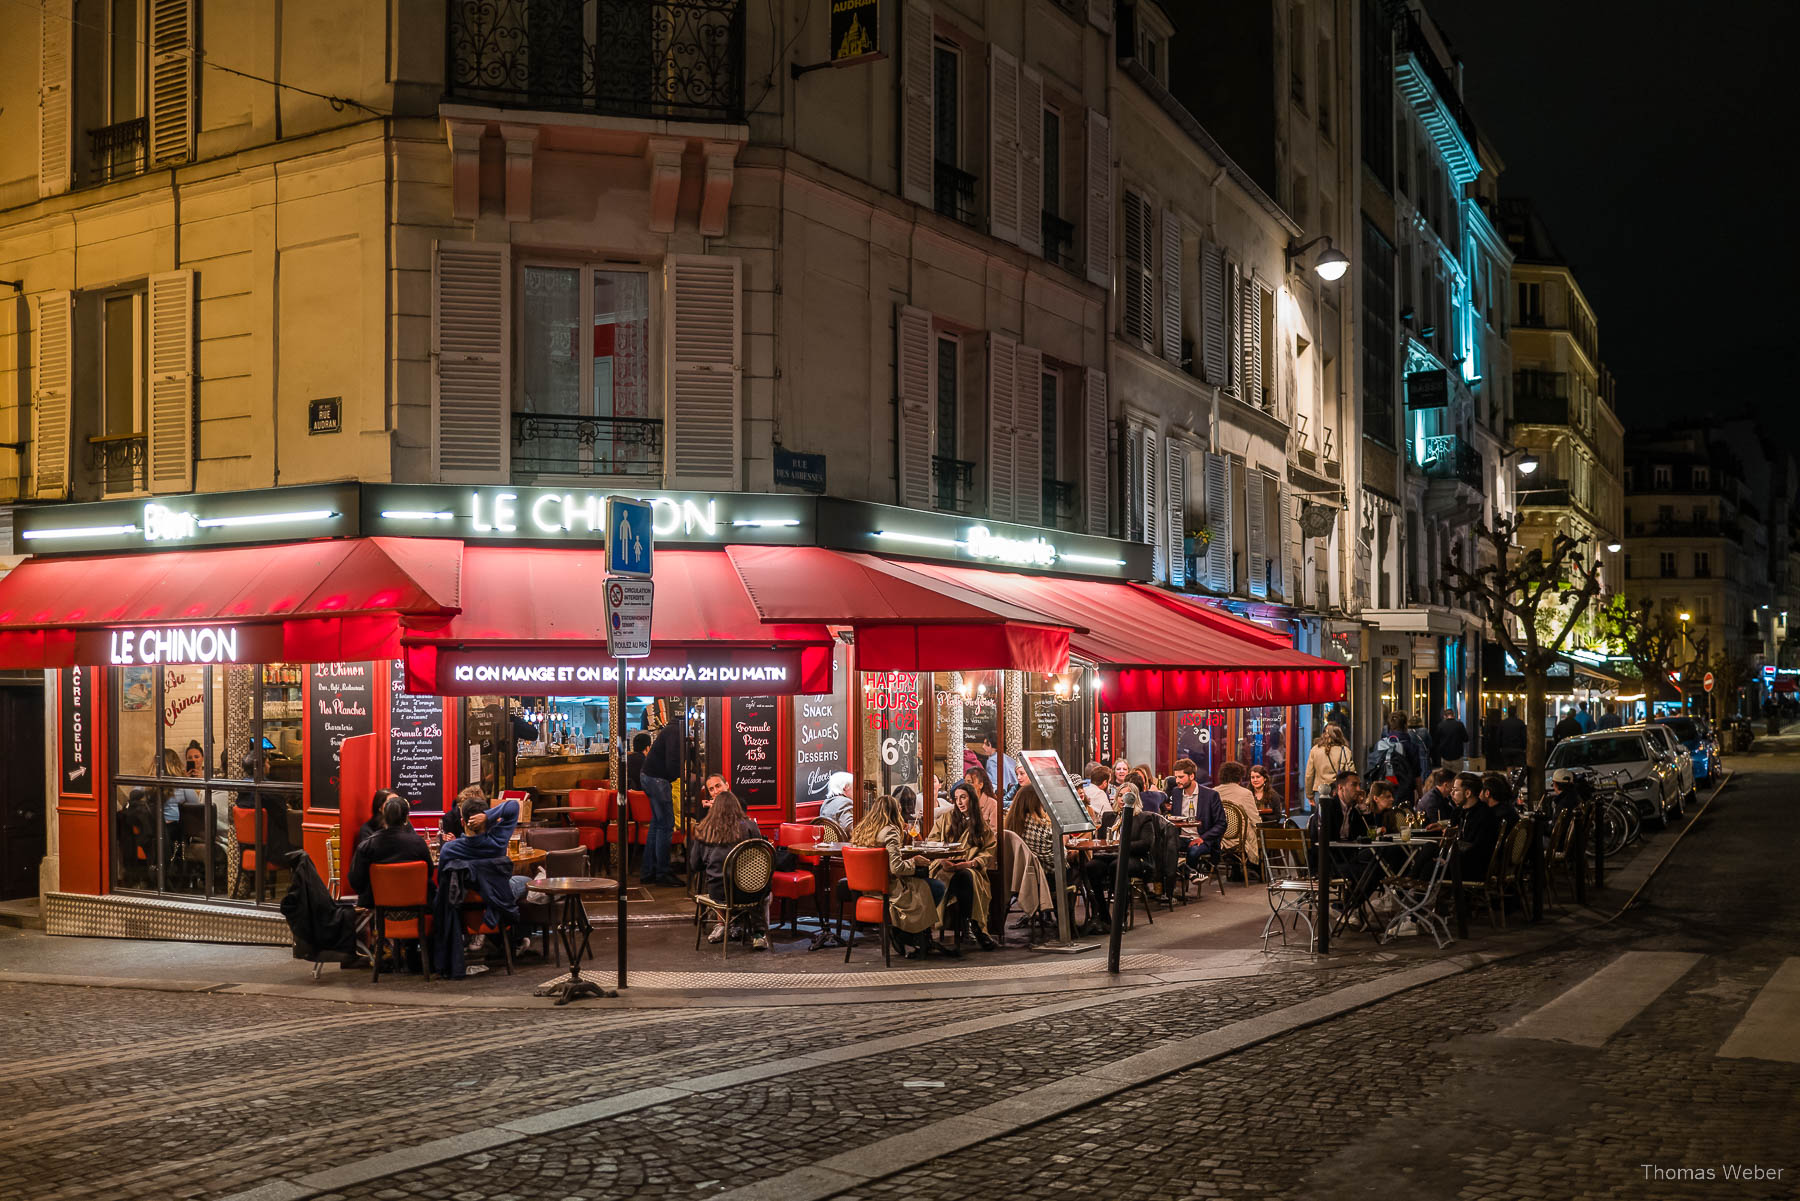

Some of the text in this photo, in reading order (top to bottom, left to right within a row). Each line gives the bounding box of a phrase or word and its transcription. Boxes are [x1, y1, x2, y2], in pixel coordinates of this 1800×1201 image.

[472, 491, 716, 537] LE CHION
[110, 627, 237, 664] LE CHINON
[615, 641, 632, 649] ROULEZ
[639, 641, 648, 649] PAS
[315, 662, 364, 677] Le Chinon
[455, 665, 473, 681] ICI
[475, 665, 499, 681] ON
[502, 666, 555, 681] MANGE
[557, 666, 574, 680] ET
[576, 666, 600, 681] ON
[698, 667, 717, 680] 2H
[719, 667, 739, 680] DU
[742, 667, 786, 681] MATIN
[866, 671, 919, 689] HAPPY
[1211, 677, 1273, 702] LE CHINON
[318, 698, 366, 715] Nos Planches
[866, 691, 920, 710] HOURS
[391, 727, 422, 738] Formule
[735, 721, 772, 732] Formule
[73, 712, 82, 762] COEUR
[742, 733, 770, 746] Pizza
[740, 765, 757, 773] pizza
[740, 777, 762, 785] boisson
